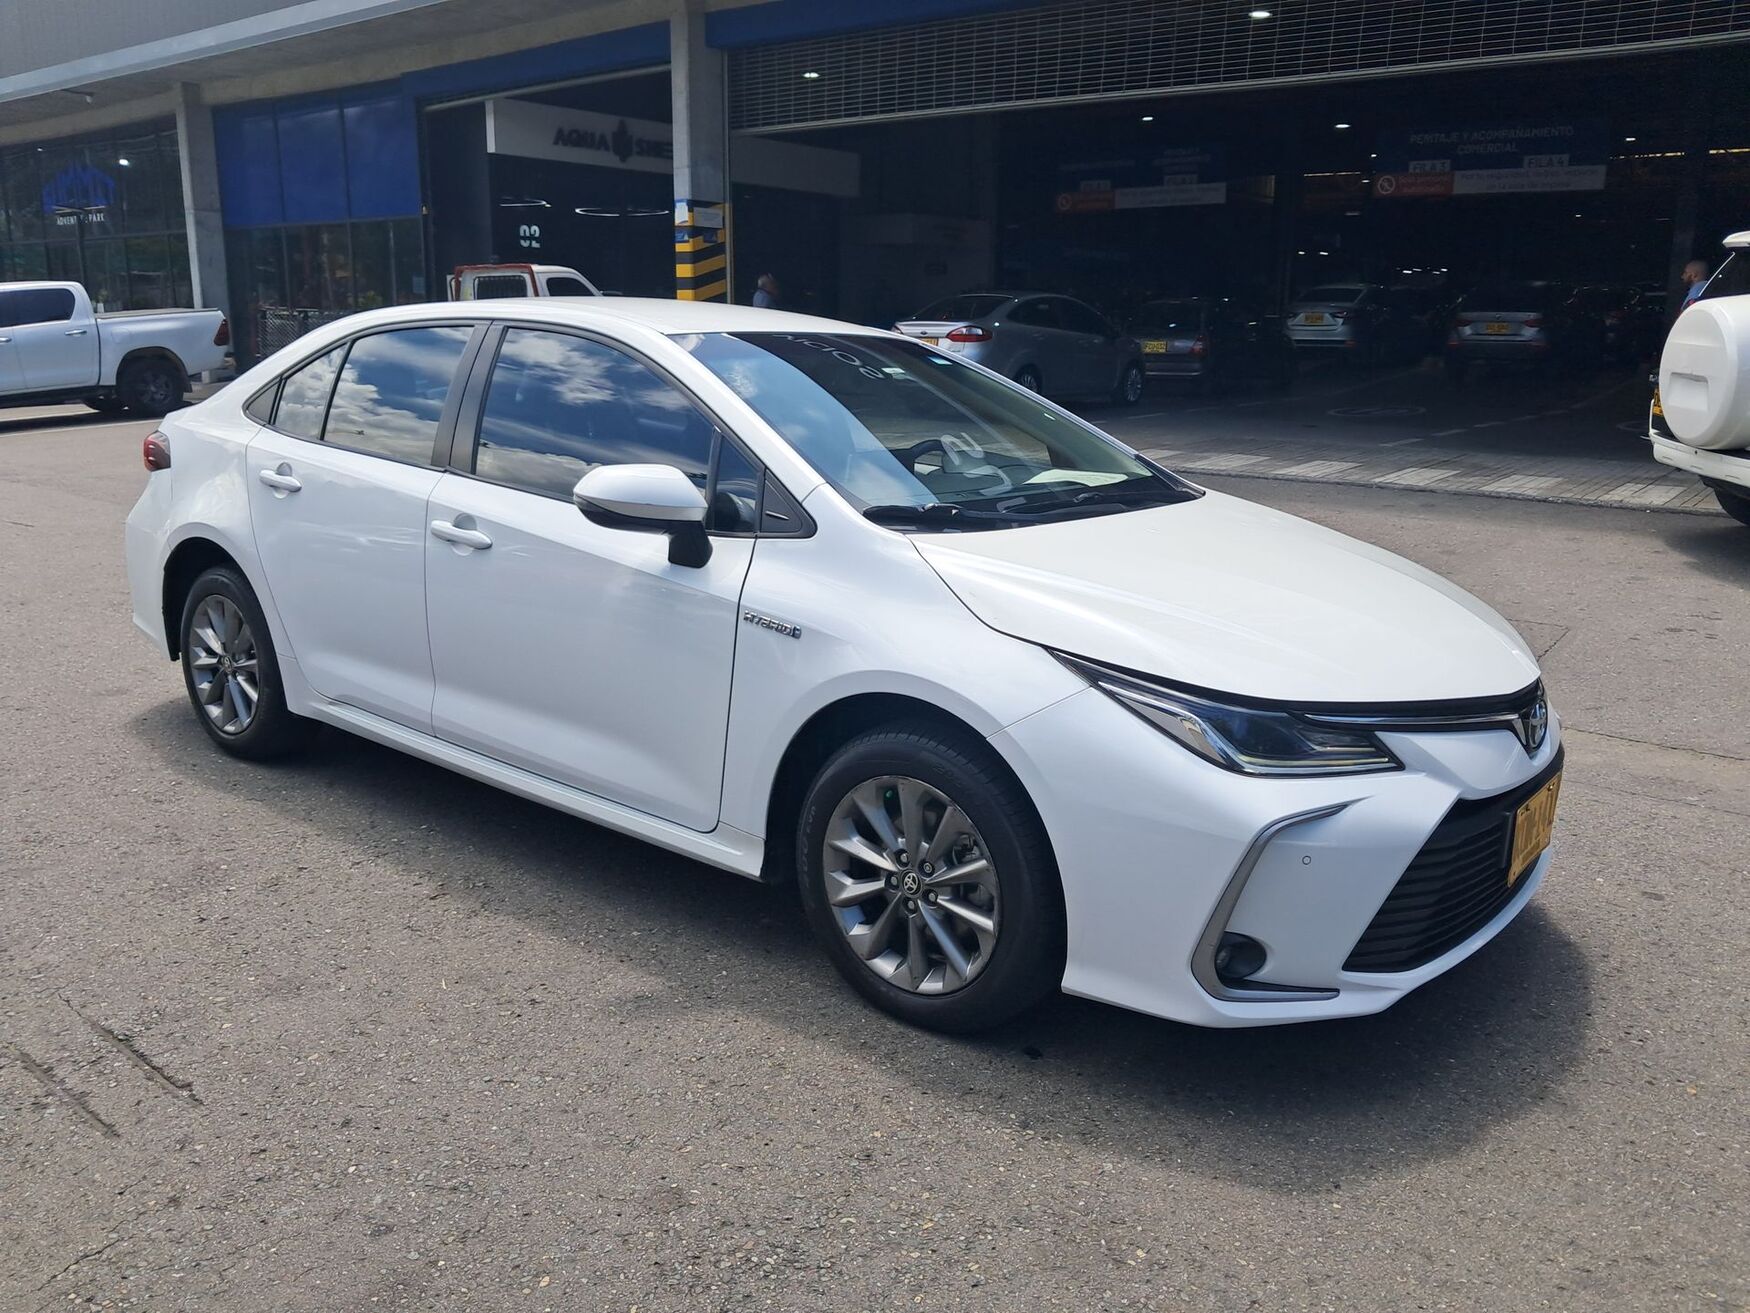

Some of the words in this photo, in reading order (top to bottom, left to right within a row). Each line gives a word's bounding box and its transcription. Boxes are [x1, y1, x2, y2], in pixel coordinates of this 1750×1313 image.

[553, 127, 611, 153] AQUA
[1456, 142, 1519, 155] COMERCIAL
[89, 213, 105, 222] PARK
[519, 224, 541, 248] 02
